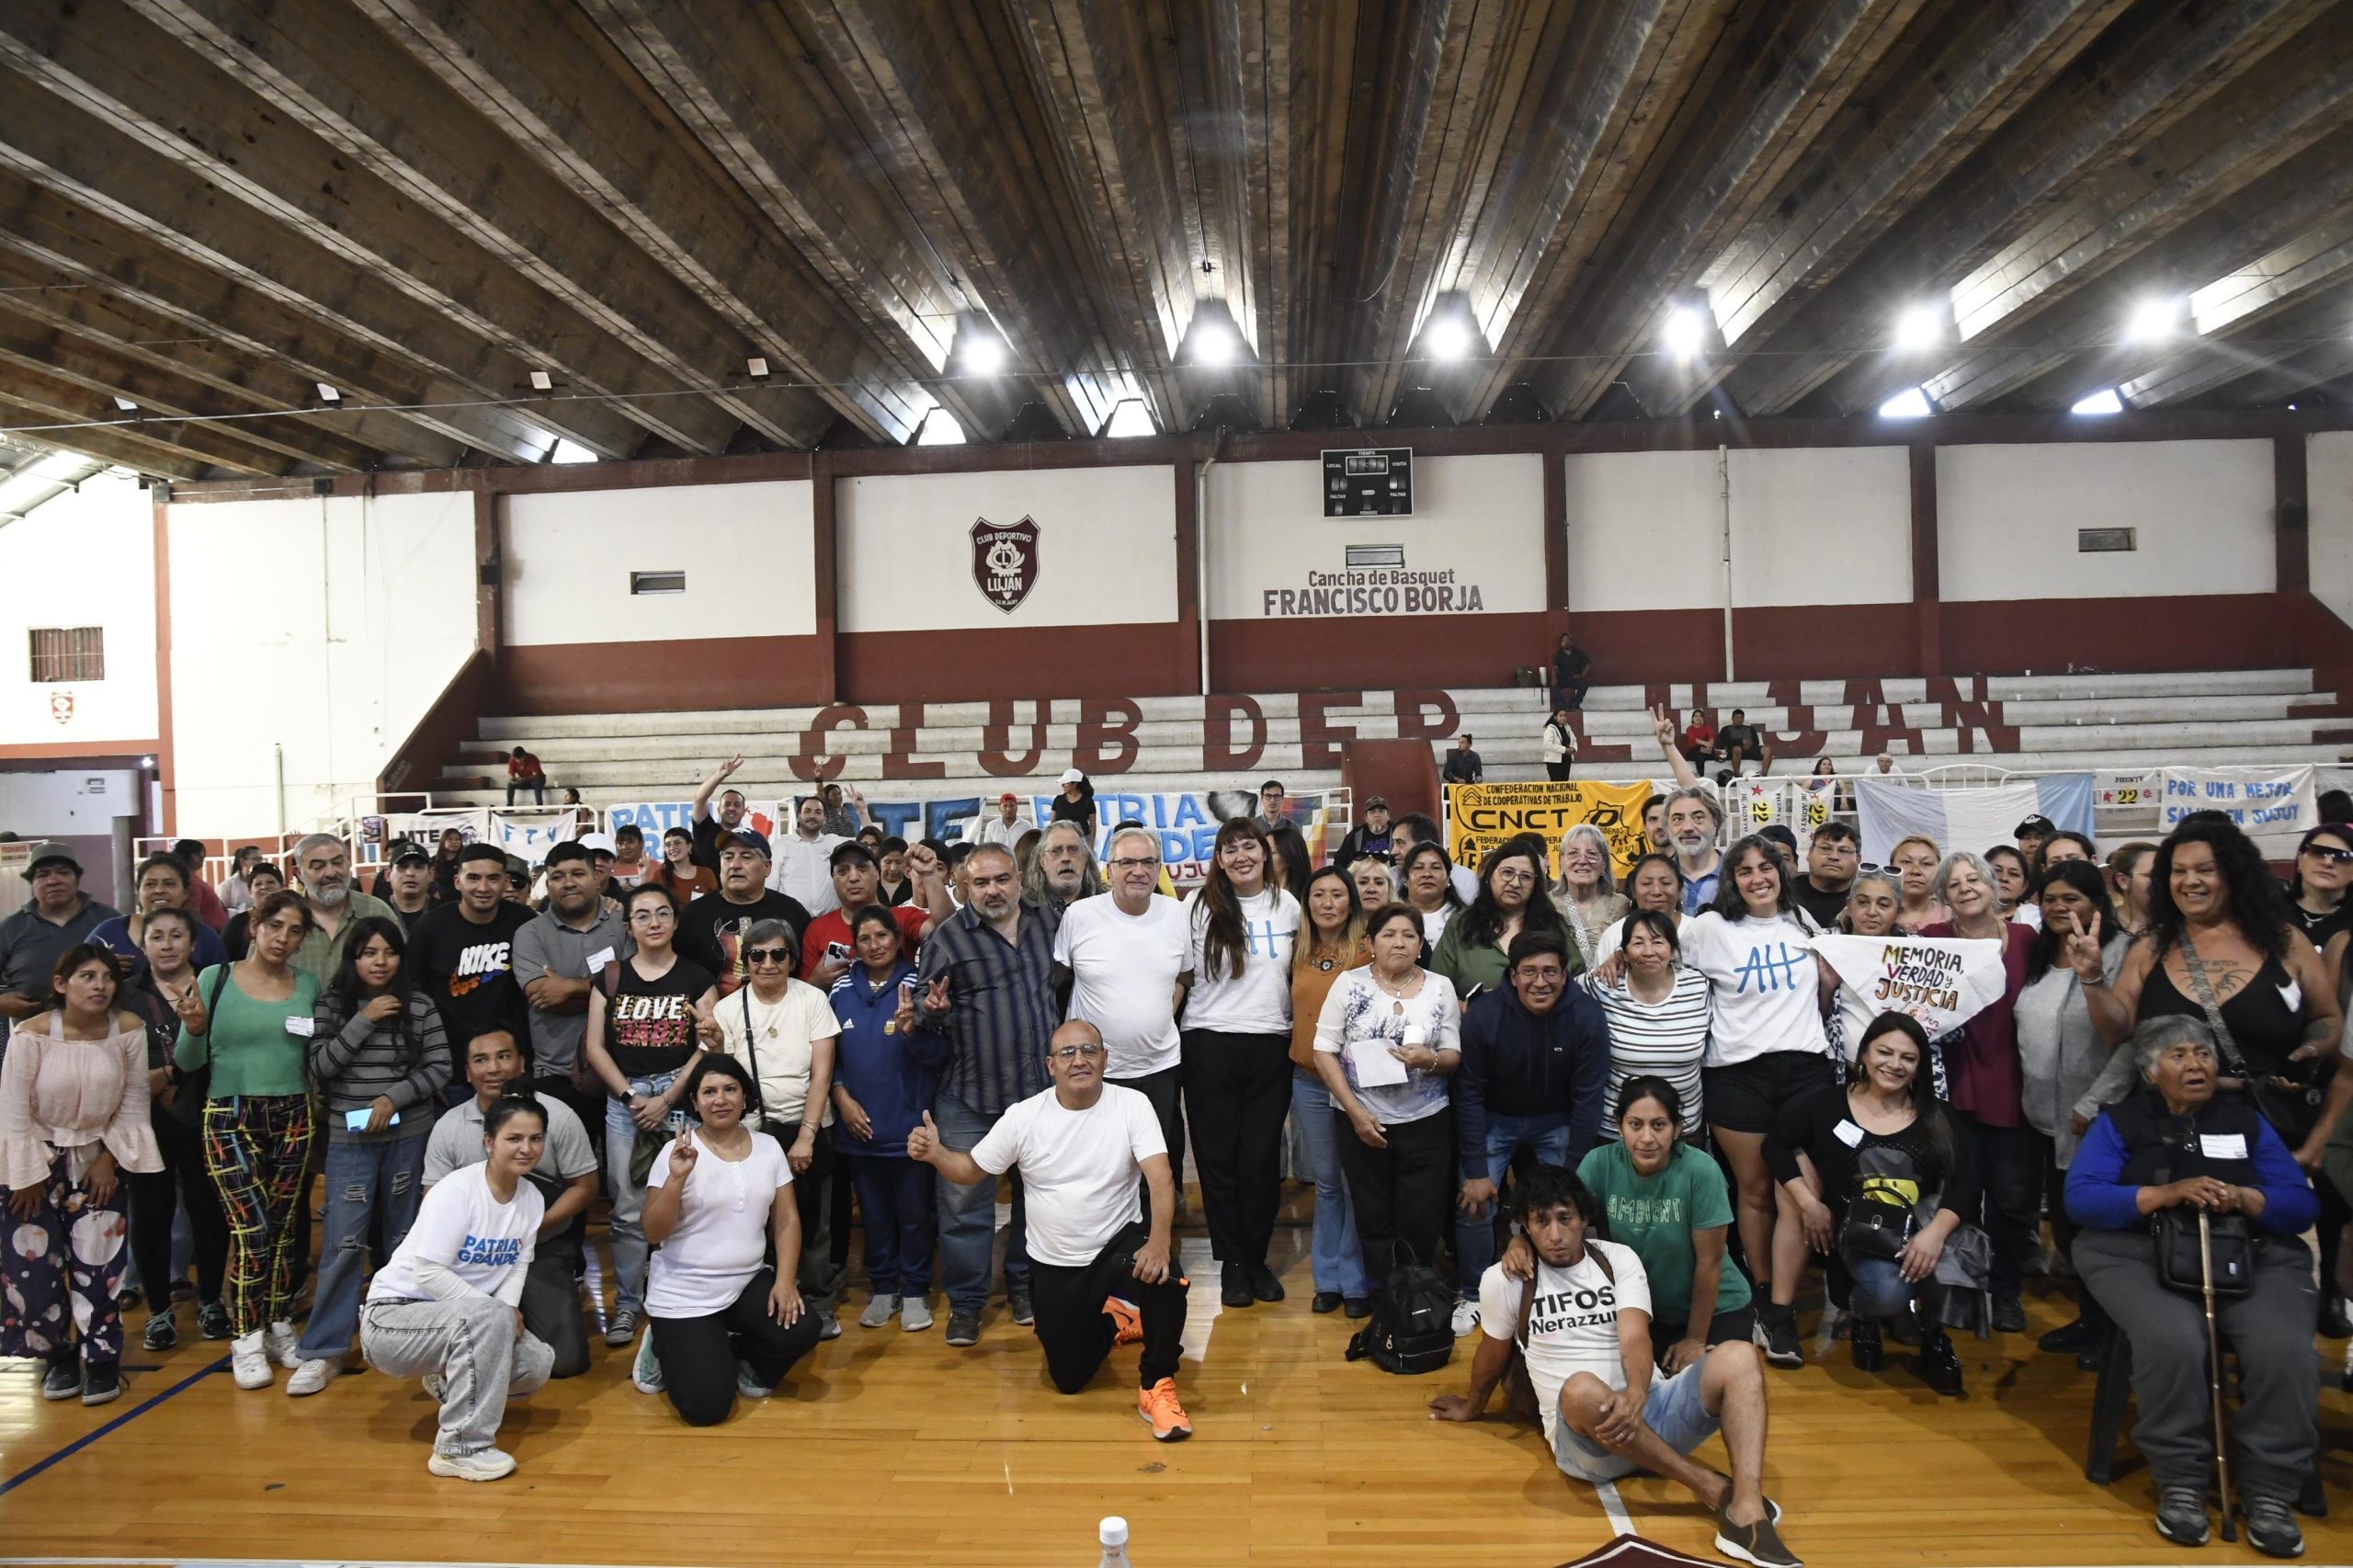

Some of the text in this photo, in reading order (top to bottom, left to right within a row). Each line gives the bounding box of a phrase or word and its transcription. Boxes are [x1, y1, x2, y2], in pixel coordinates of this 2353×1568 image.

[976, 531, 1032, 545] CLUB DEPORTIVO
[987, 577, 1022, 592] LUJAN
[1308, 568, 1455, 587] Cancha de Basquet
[1263, 585, 1484, 616] FRANCISCO BORJA
[788, 697, 1142, 782] CLUB
[1486, 782, 1579, 794] CONFEDERACION NACIONAL
[2118, 790, 2138, 804] 22
[2167, 779, 2294, 799] POR UNA MEJOR
[1483, 793, 1583, 806] DE COOPERATIVAS DE TRABAJO
[1034, 793, 1207, 827] PTRIA
[1471, 808, 1569, 829] CNCT
[1752, 802, 1768, 824] 22
[1808, 804, 1824, 824] 22
[2252, 804, 2299, 824] JUJUY
[843, 797, 980, 845] TE
[398, 829, 440, 844] MTE
[1475, 835, 1509, 845] FEDERAC
[458, 941, 511, 976] NIKE
[1733, 941, 1808, 994] AH
[1881, 944, 1965, 975] MEMORIA,
[1887, 964, 1944, 988] VERDAD
[1874, 977, 1959, 1011] JUSTICIA
[617, 995, 685, 1019] LOVE
[462, 1234, 518, 1253] PATRIA
[457, 1248, 520, 1267] GRANDE
[1532, 1285, 1616, 1318] TIFOS
